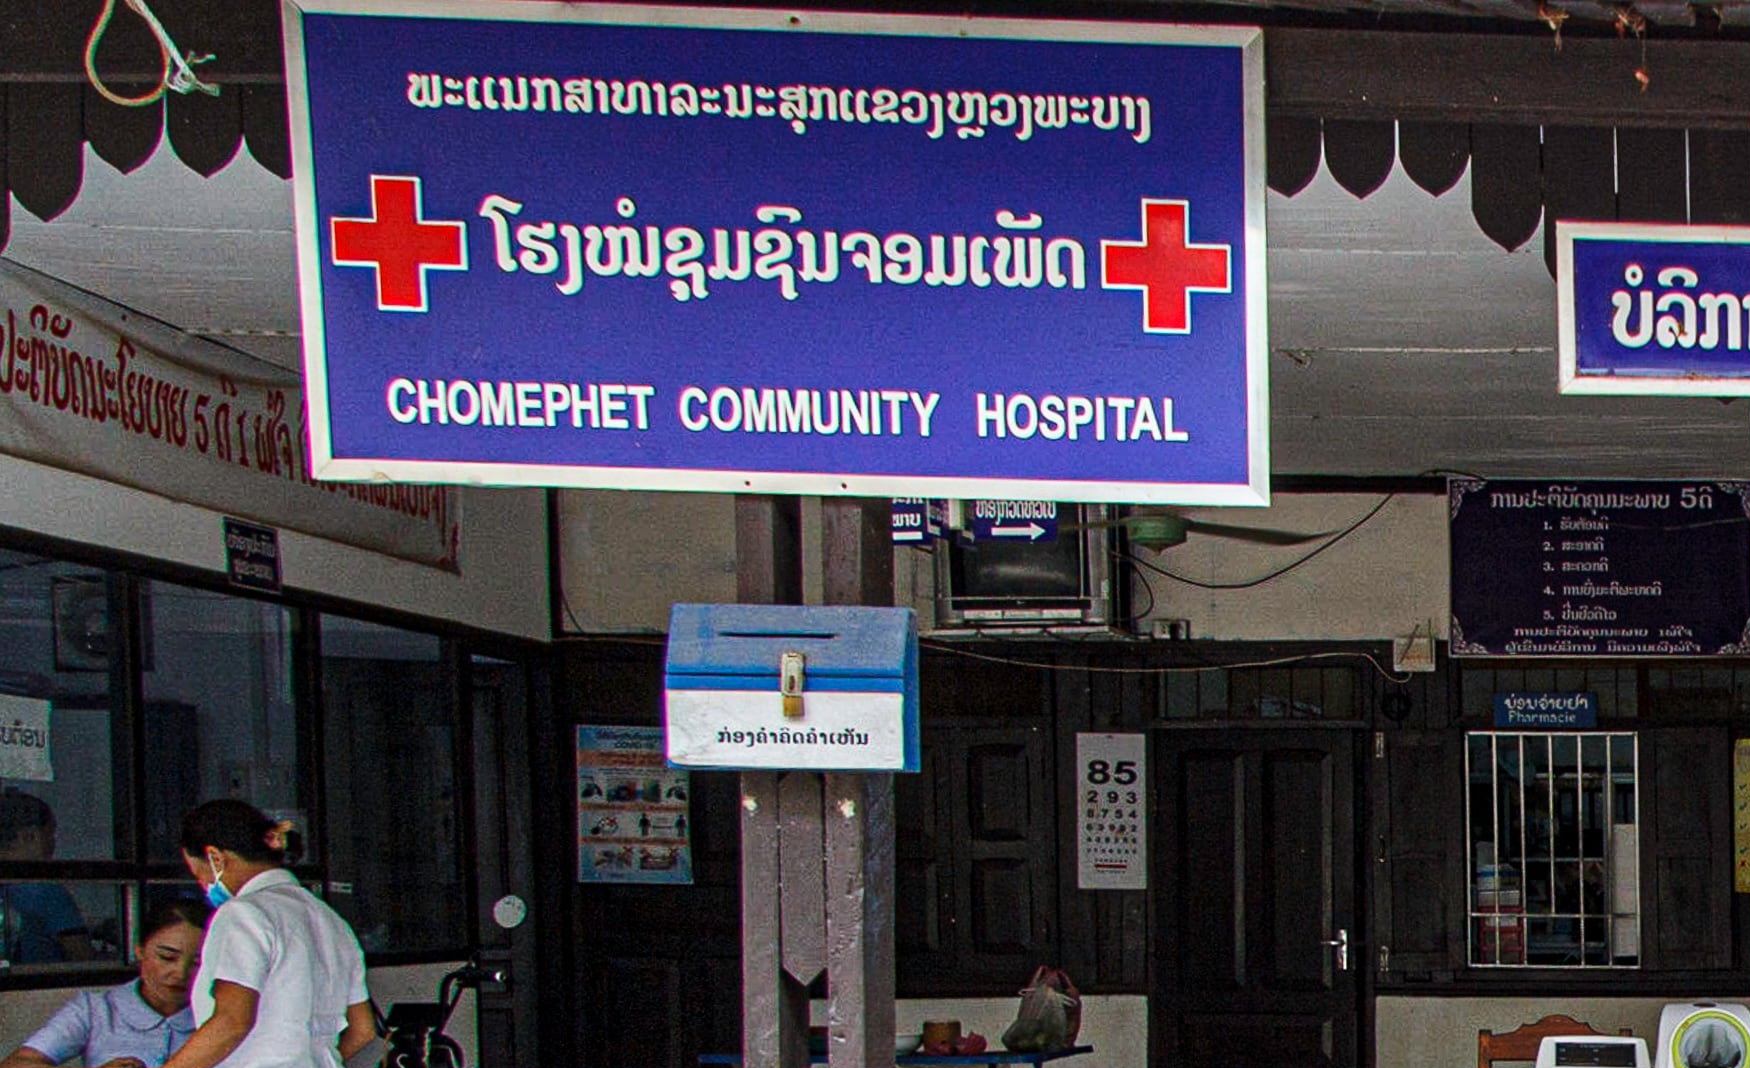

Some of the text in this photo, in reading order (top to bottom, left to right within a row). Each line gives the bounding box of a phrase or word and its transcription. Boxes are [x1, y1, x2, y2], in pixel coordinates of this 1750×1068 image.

[387, 375, 1190, 445] CHOMEPHET COMMUNITY HOSPITAL
[193, 393, 212, 454] 5
[1541, 560, 1555, 572] 3.
[1541, 585, 1556, 597] 4.
[1508, 711, 1577, 724] Pharmacie
